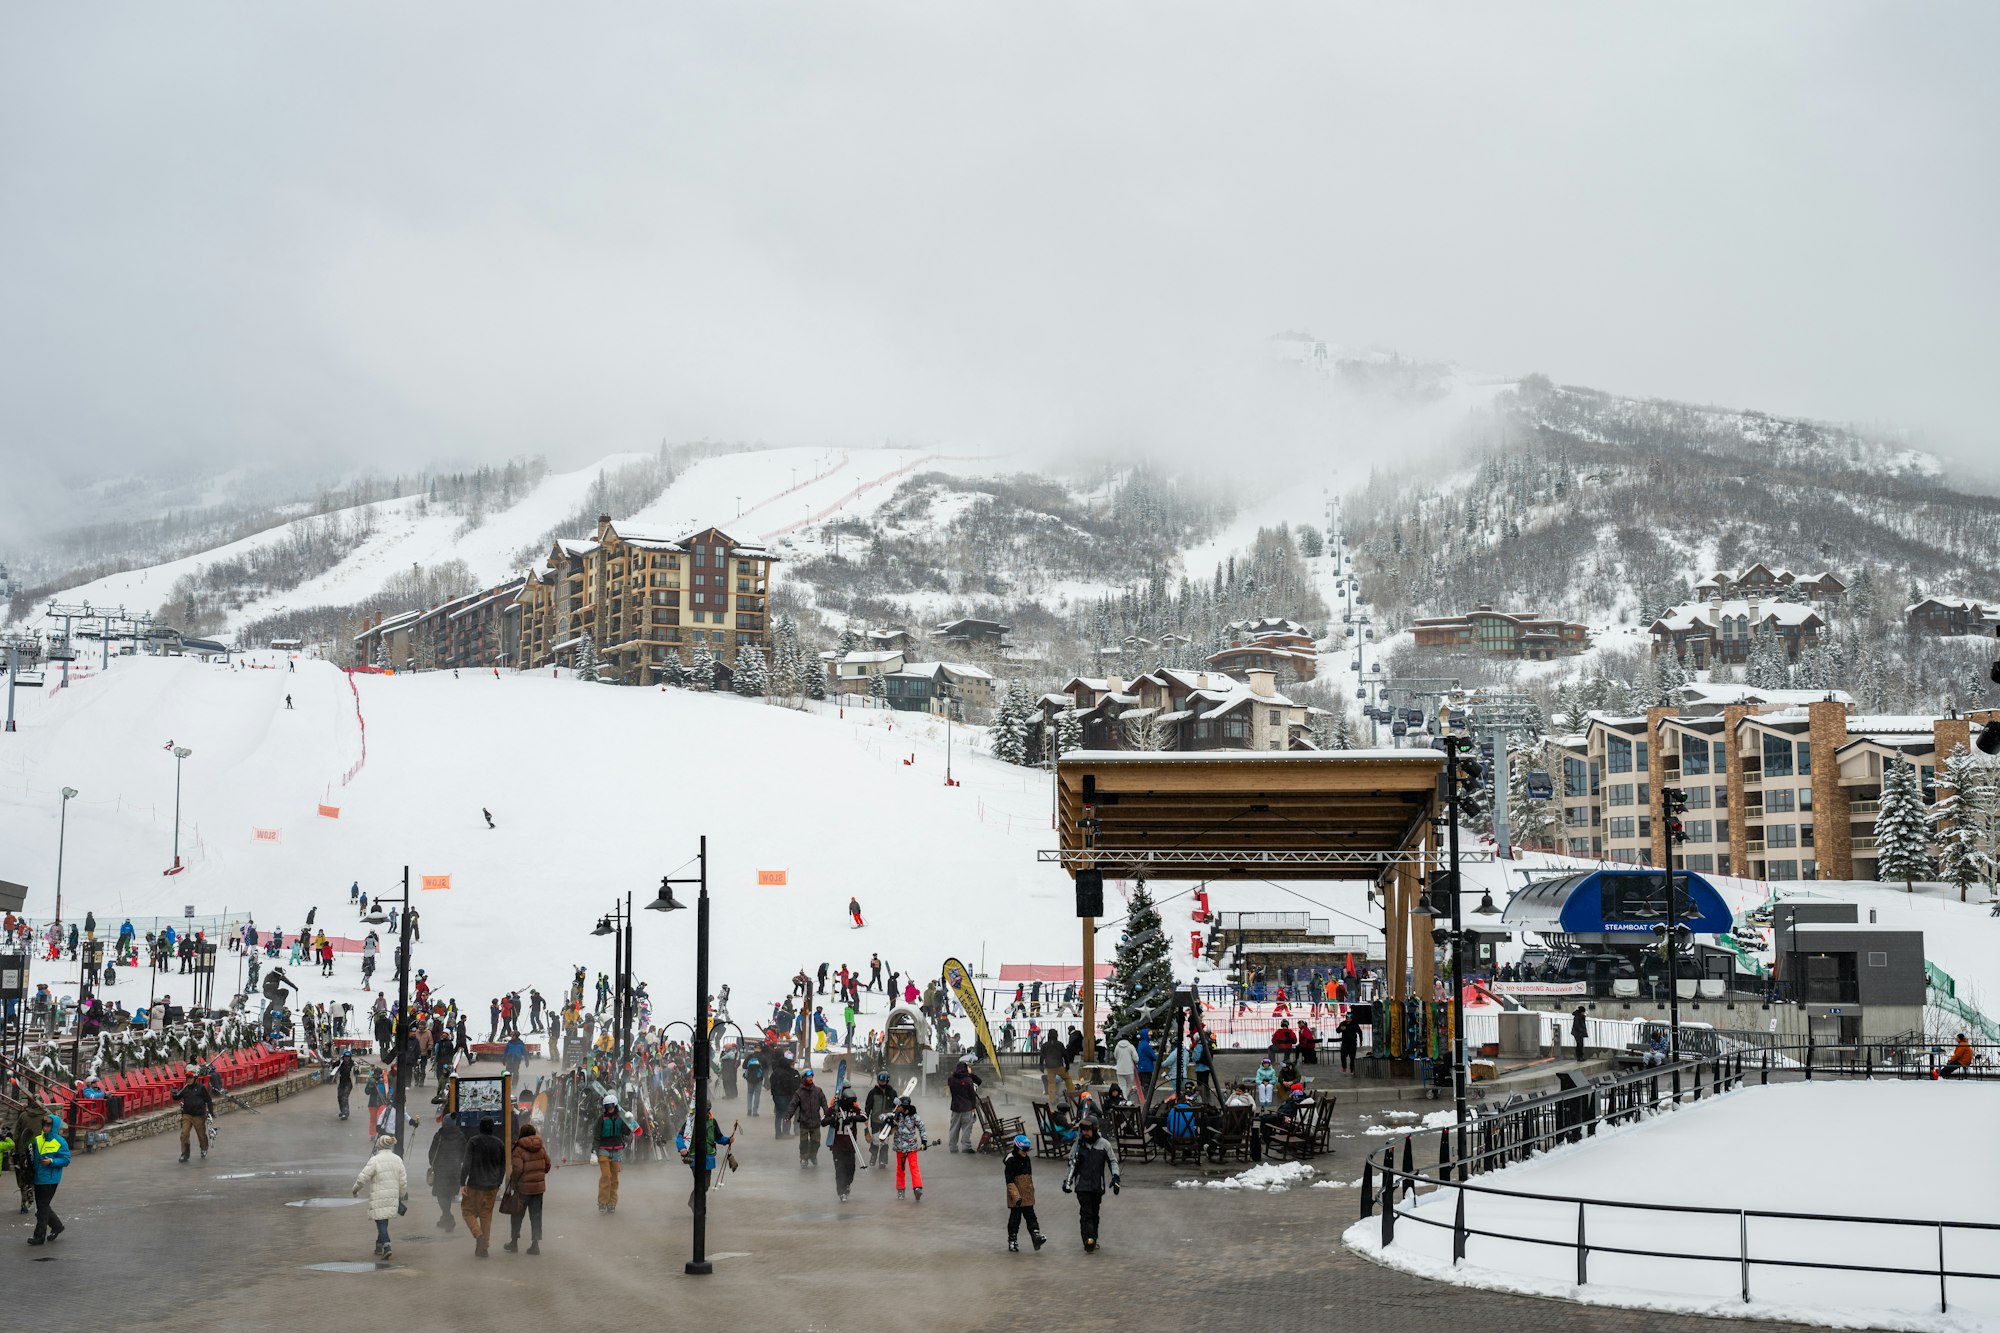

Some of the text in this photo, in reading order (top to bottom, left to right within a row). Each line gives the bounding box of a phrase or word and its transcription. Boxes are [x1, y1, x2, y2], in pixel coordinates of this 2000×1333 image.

[1604, 923, 1648, 931] STEAMBOAT
[958, 994, 979, 1028] LESSONS
[965, 989, 982, 1020] PRIVATE
